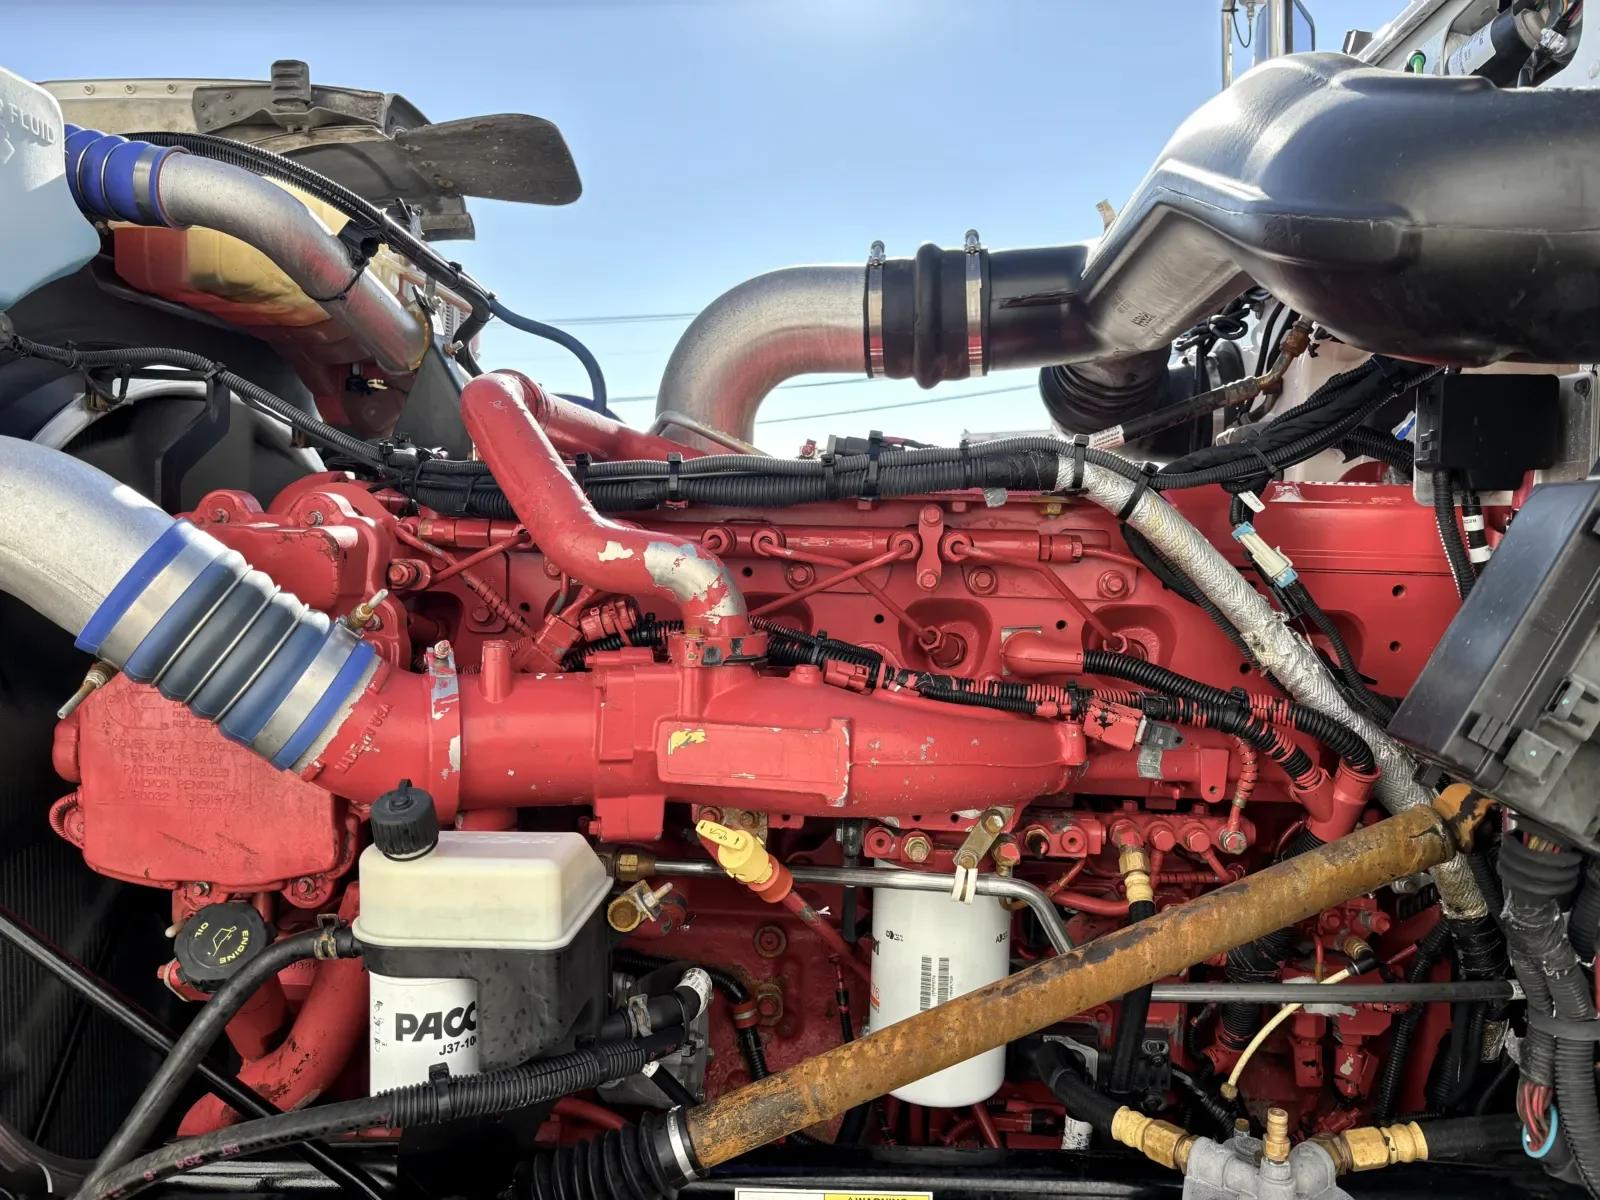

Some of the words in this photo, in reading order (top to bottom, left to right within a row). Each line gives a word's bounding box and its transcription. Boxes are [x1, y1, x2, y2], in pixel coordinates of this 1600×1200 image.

[8, 102, 56, 145] FLUID
[193, 921, 209, 940] OIL
[218, 929, 249, 965] ENGINE
